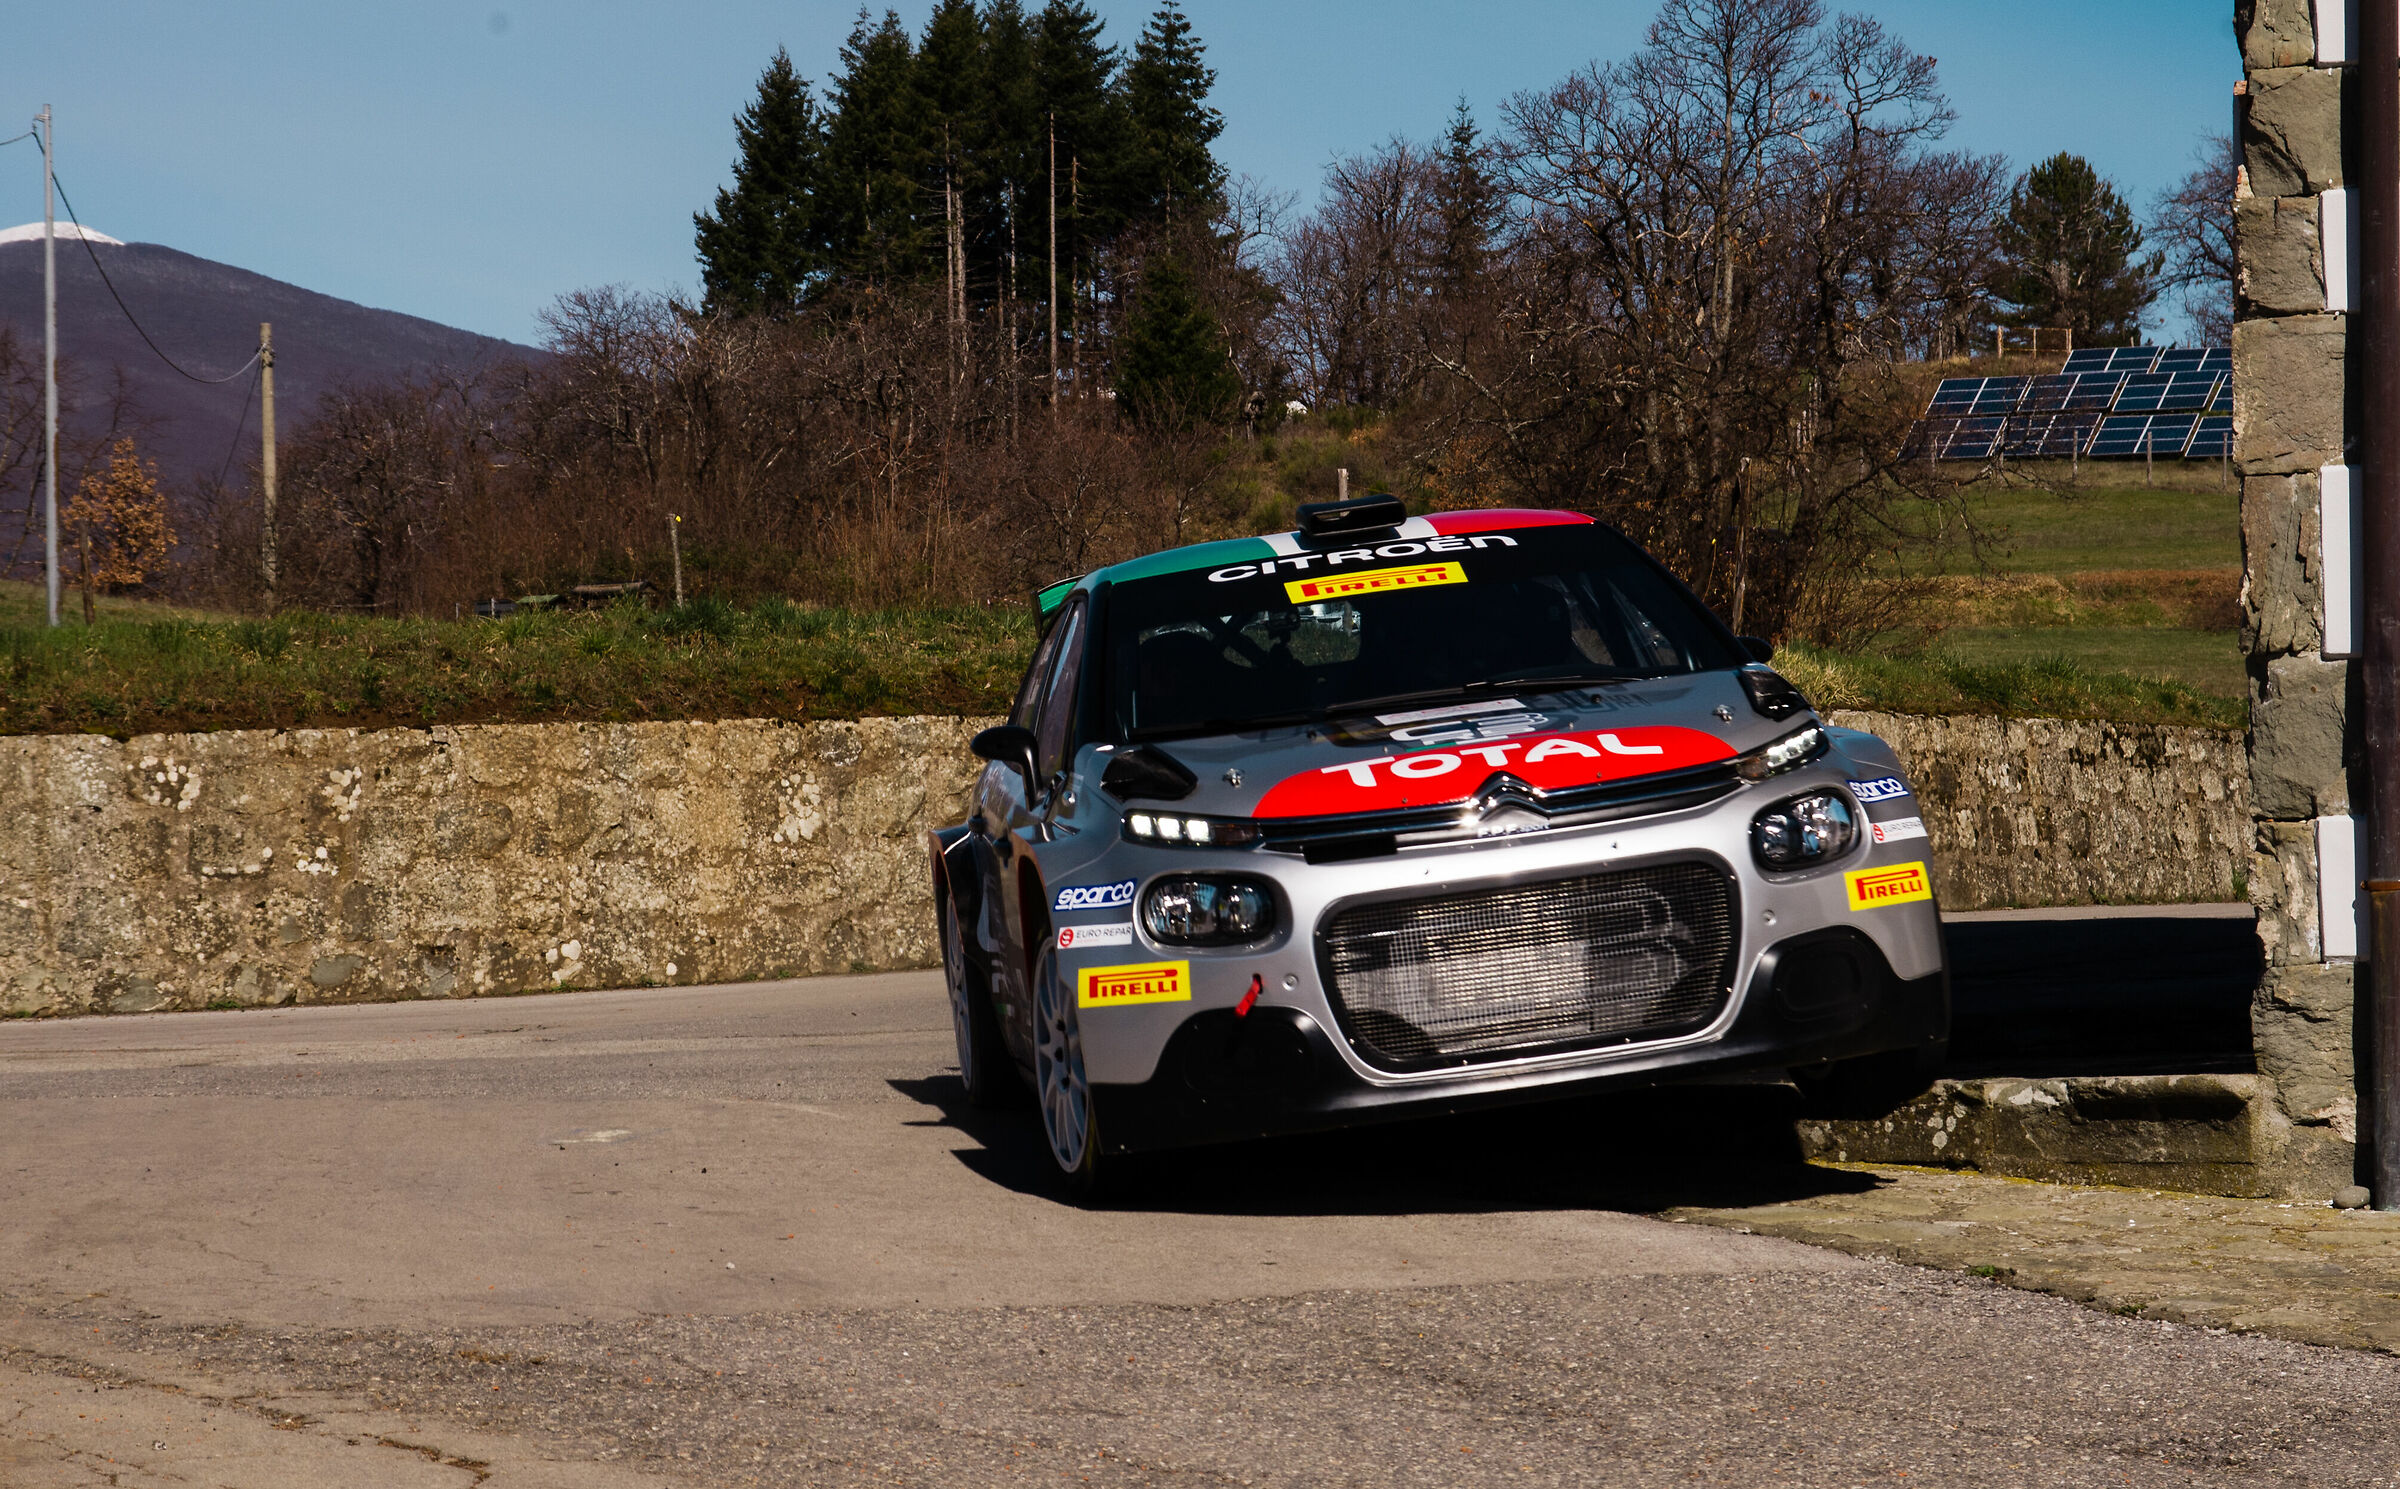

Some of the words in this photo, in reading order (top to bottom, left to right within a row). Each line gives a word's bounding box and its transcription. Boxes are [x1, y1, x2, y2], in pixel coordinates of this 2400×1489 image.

[1208, 535, 1519, 582] CITROËN
[1301, 566, 1448, 597] PIRELLI
[1321, 733, 1664, 788] TOTAL
[1848, 777, 1904, 799] sparco
[1057, 880, 1135, 911] sparco
[1856, 869, 1923, 901] PIRELLI
[1076, 928, 1101, 939] EURO
[1103, 926, 1132, 937] REPAR
[1089, 968, 1178, 998] PIRELLI
